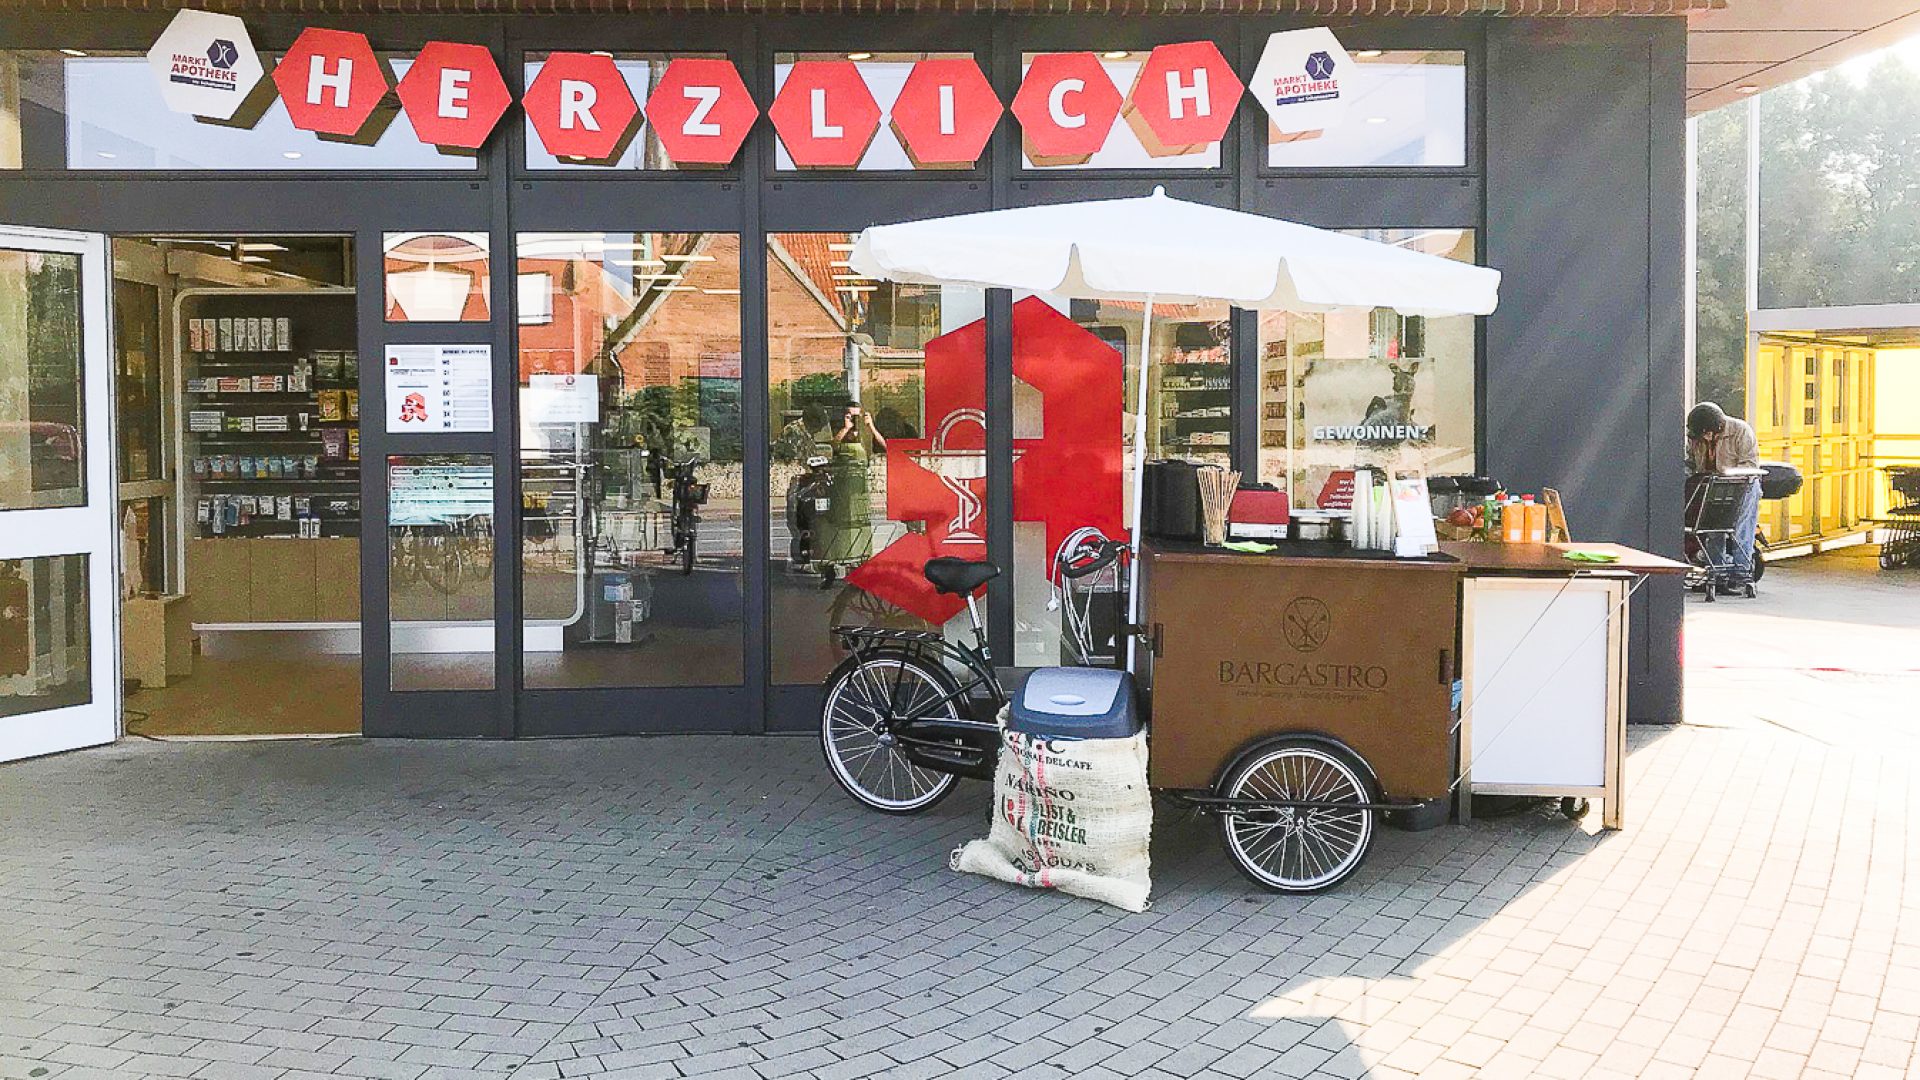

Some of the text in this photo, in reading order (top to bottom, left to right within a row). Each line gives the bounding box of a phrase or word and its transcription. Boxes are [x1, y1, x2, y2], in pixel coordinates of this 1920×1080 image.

[172, 53, 207, 66] MARKT
[171, 63, 238, 82] APOTHEKE
[1273, 75, 1307, 86] MARKT
[1275, 79, 1338, 96] APOTHEKE
[1313, 425, 1429, 440] GEWONNEN?
[1219, 660, 1388, 689] BARGASTRO
[1046, 756, 1066, 768] DEL
[1066, 759, 1093, 771] CAFE
[1039, 802, 1065, 820] LIST
[1037, 818, 1087, 845] BEISLER
